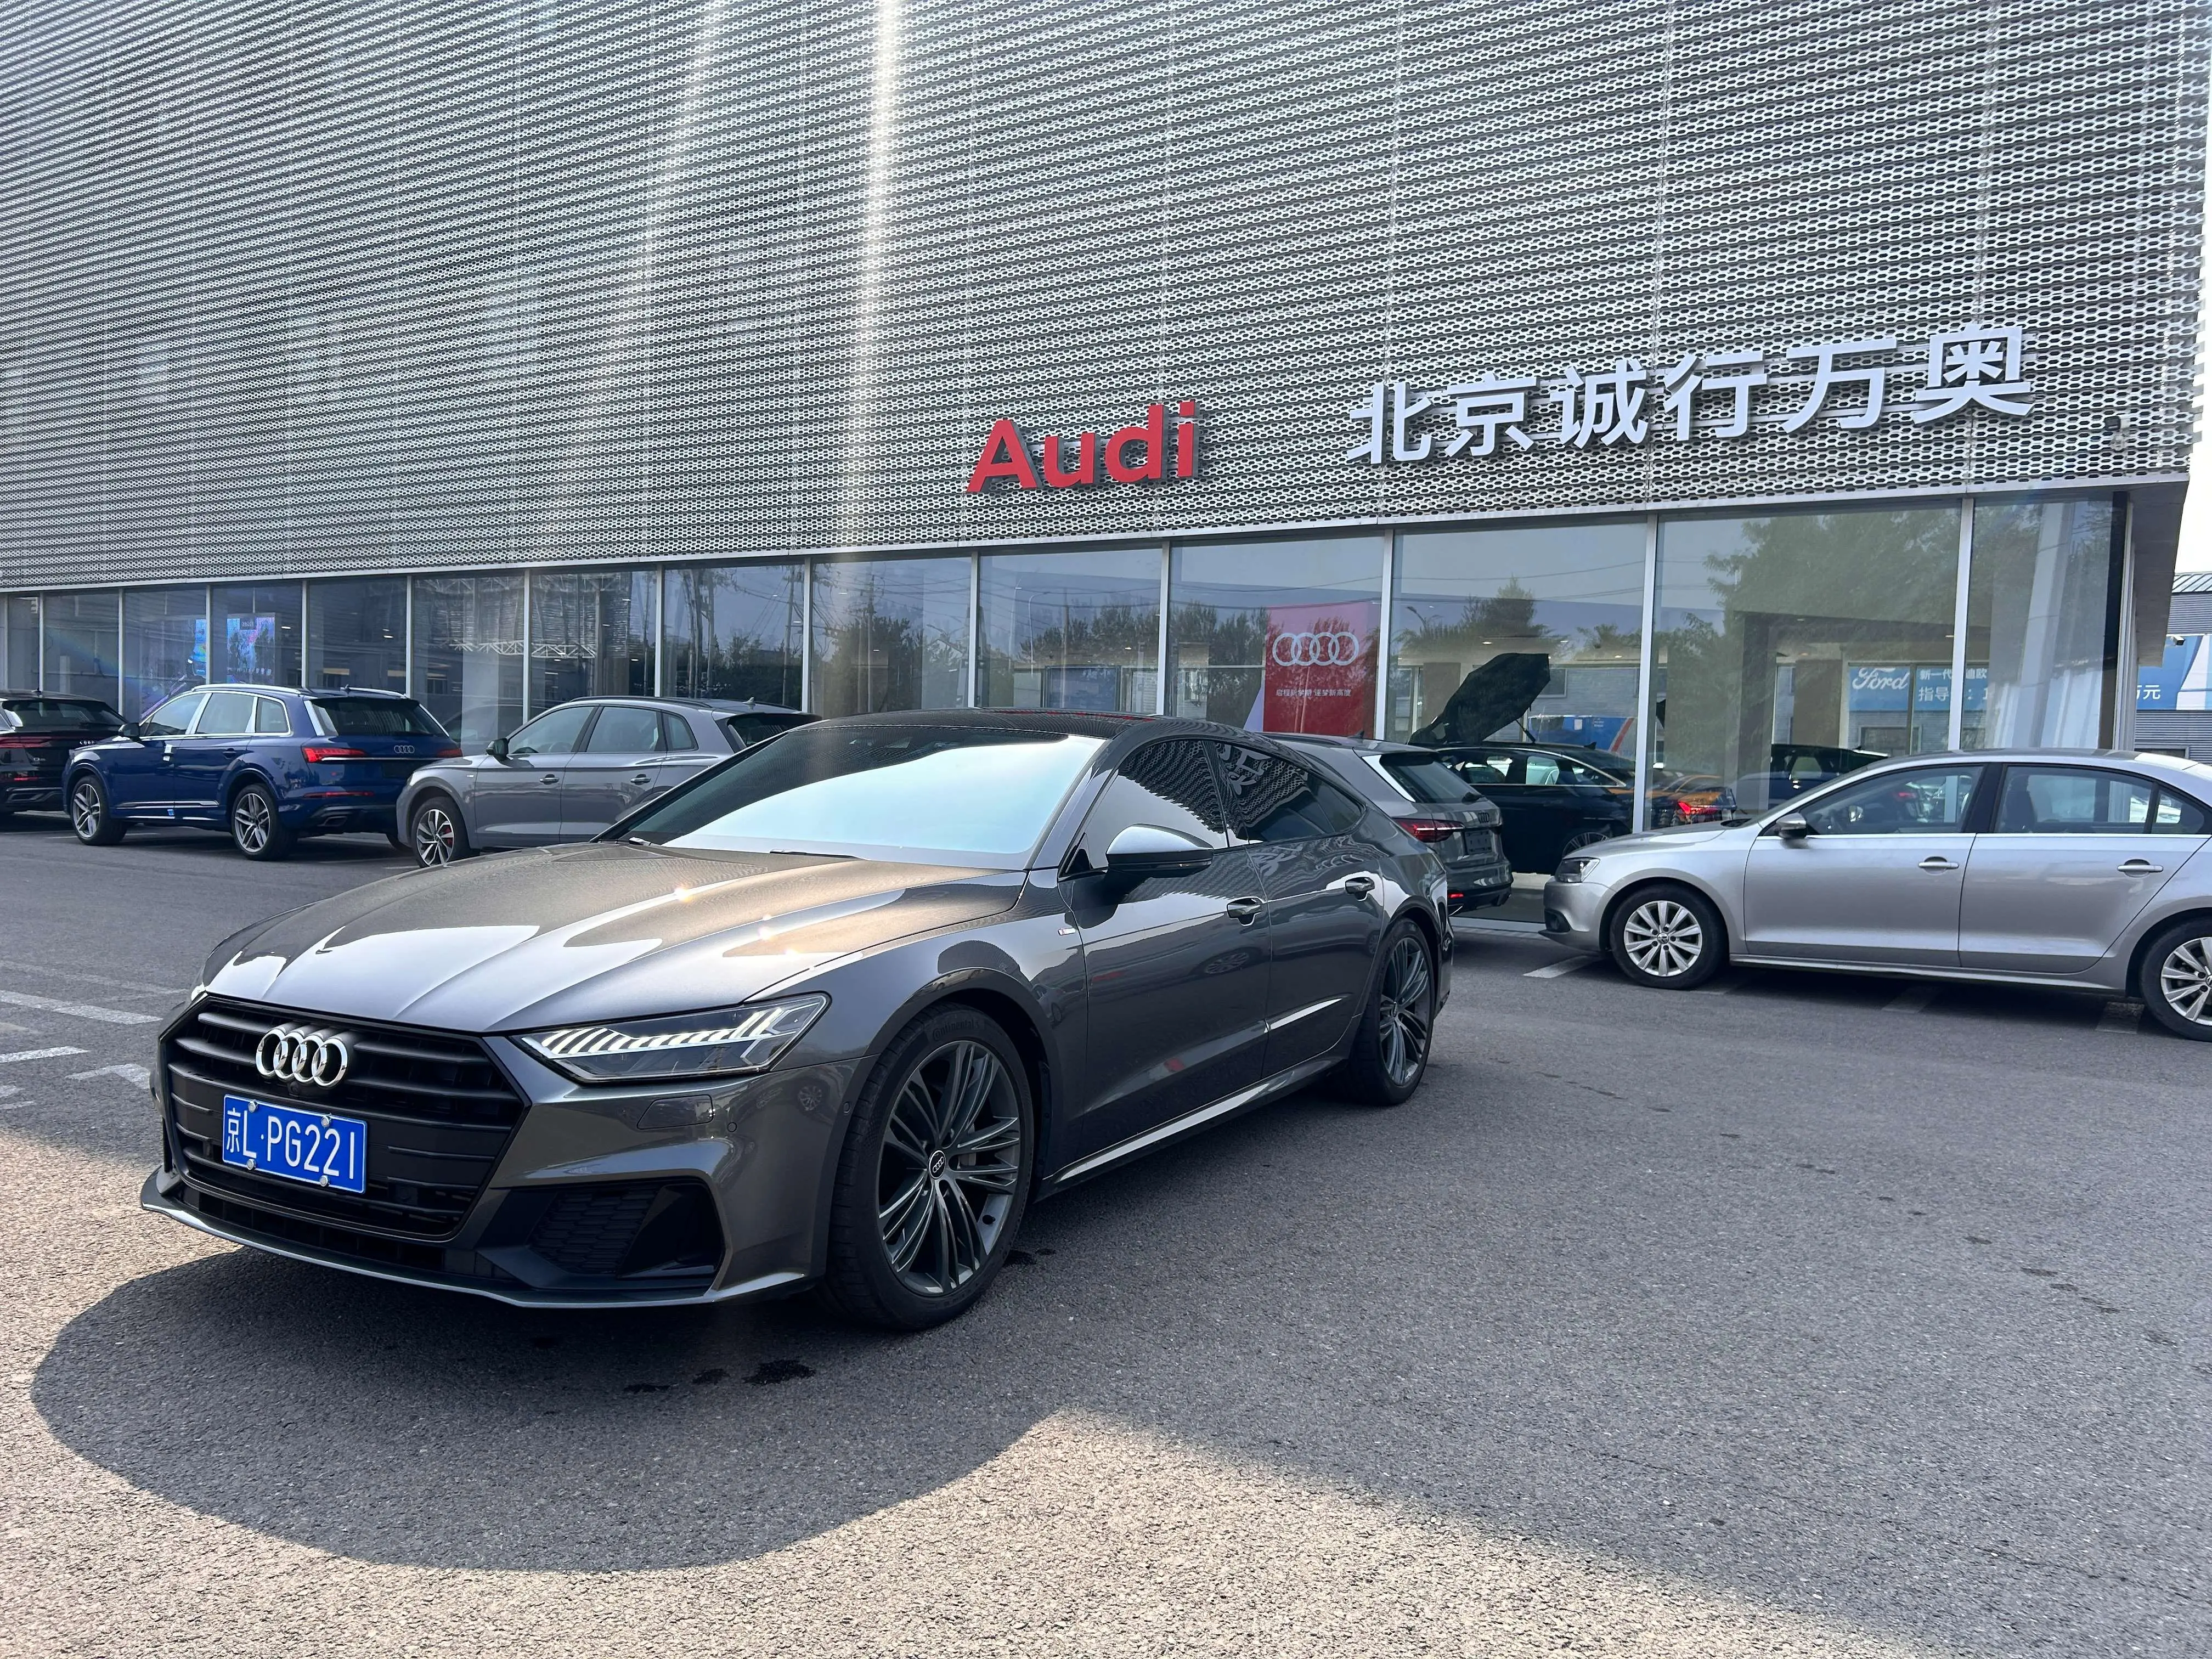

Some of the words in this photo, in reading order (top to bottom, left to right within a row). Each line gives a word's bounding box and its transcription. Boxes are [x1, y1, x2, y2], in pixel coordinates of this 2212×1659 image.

[1346, 324, 2033, 464] 北京诚行万奥
[966, 401, 1199, 493] Audi
[1852, 667, 1910, 690] Ford
[932, 1018, 974, 1041] Continental
